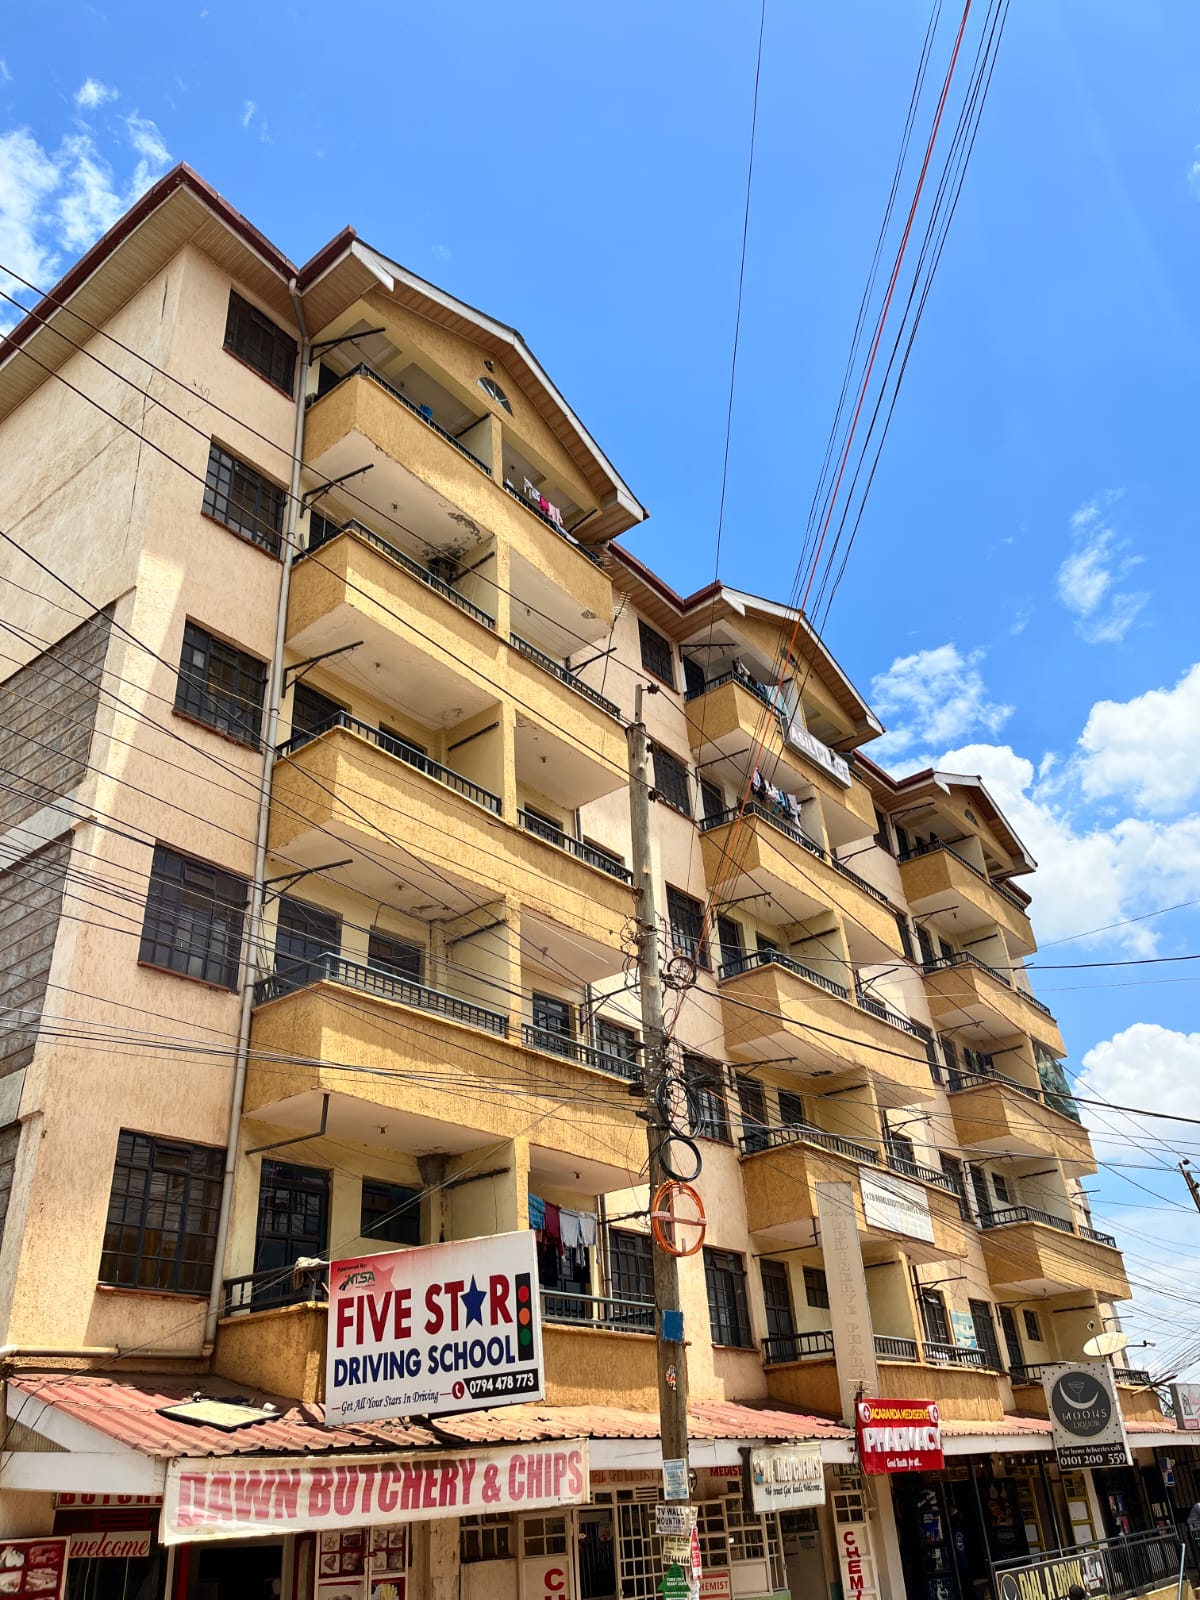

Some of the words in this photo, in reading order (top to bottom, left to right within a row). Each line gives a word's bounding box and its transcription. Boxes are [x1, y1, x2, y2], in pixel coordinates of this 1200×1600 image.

[346, 1271, 375, 1285] NTSA
[336, 1288, 412, 1348] FIVE
[334, 1348, 422, 1388] DRIVING
[427, 1335, 516, 1374] SCHOOL
[469, 1377, 495, 1394] 0794
[495, 1375, 514, 1390] 478
[515, 1373, 535, 1387] 773
[341, 1401, 354, 1415] Get
[355, 1398, 365, 1410] All
[366, 1396, 383, 1409] Your
[384, 1394, 402, 1407] Stars
[403, 1393, 412, 1403] In
[413, 1391, 439, 1405] Driving
[1062, 1408, 1107, 1420] MOONS
[862, 1426, 942, 1453] PHARMACY
[1060, 1456, 1082, 1466] 0101
[1083, 1454, 1103, 1464] 200
[1107, 1452, 1126, 1464] 559
[308, 1458, 476, 1517] BUTCHERY
[481, 1463, 502, 1504] &
[508, 1449, 583, 1501] CHIPS
[70, 1532, 150, 1557] welcome
[700, 1581, 729, 1592] HEMIST
